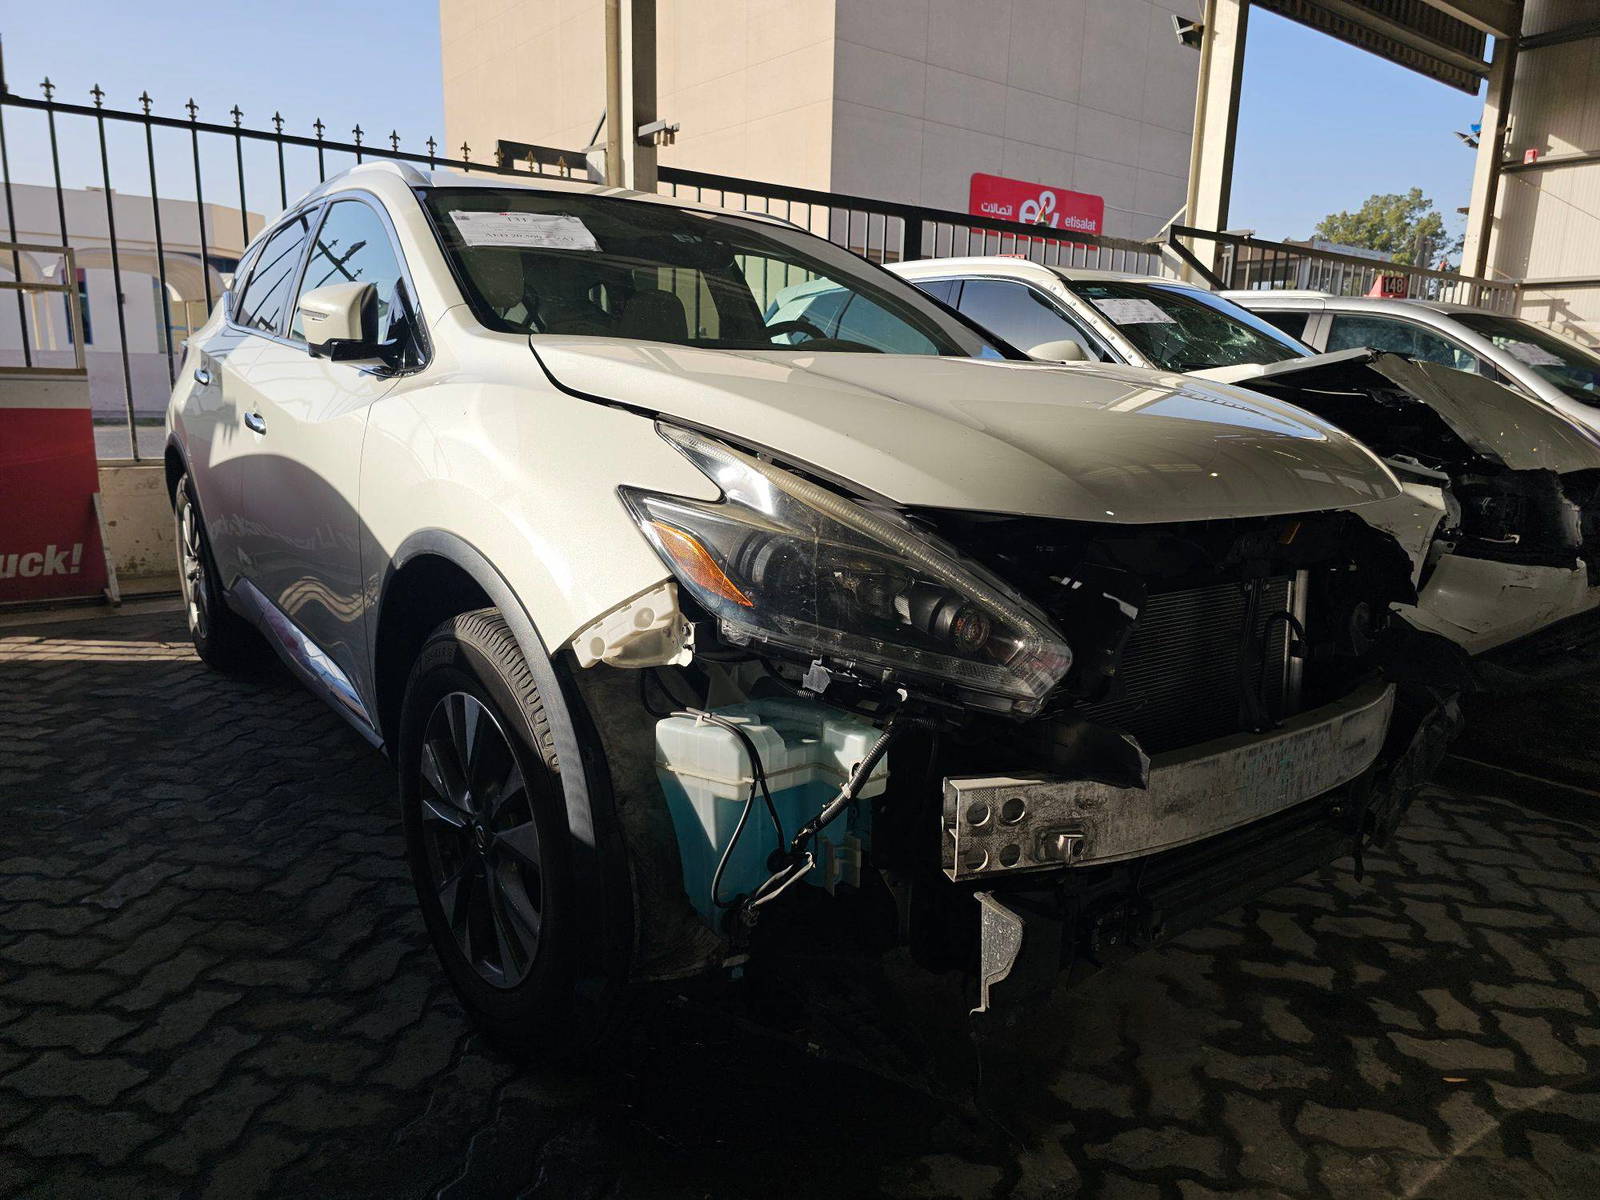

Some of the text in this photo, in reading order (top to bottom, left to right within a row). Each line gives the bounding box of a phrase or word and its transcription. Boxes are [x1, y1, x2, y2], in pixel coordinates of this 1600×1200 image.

[981, 201, 1012, 216] اتصالات
[1064, 216, 1096, 231] etisalat
[1385, 278, 1403, 293] 148
[0, 543, 83, 579] uck!
